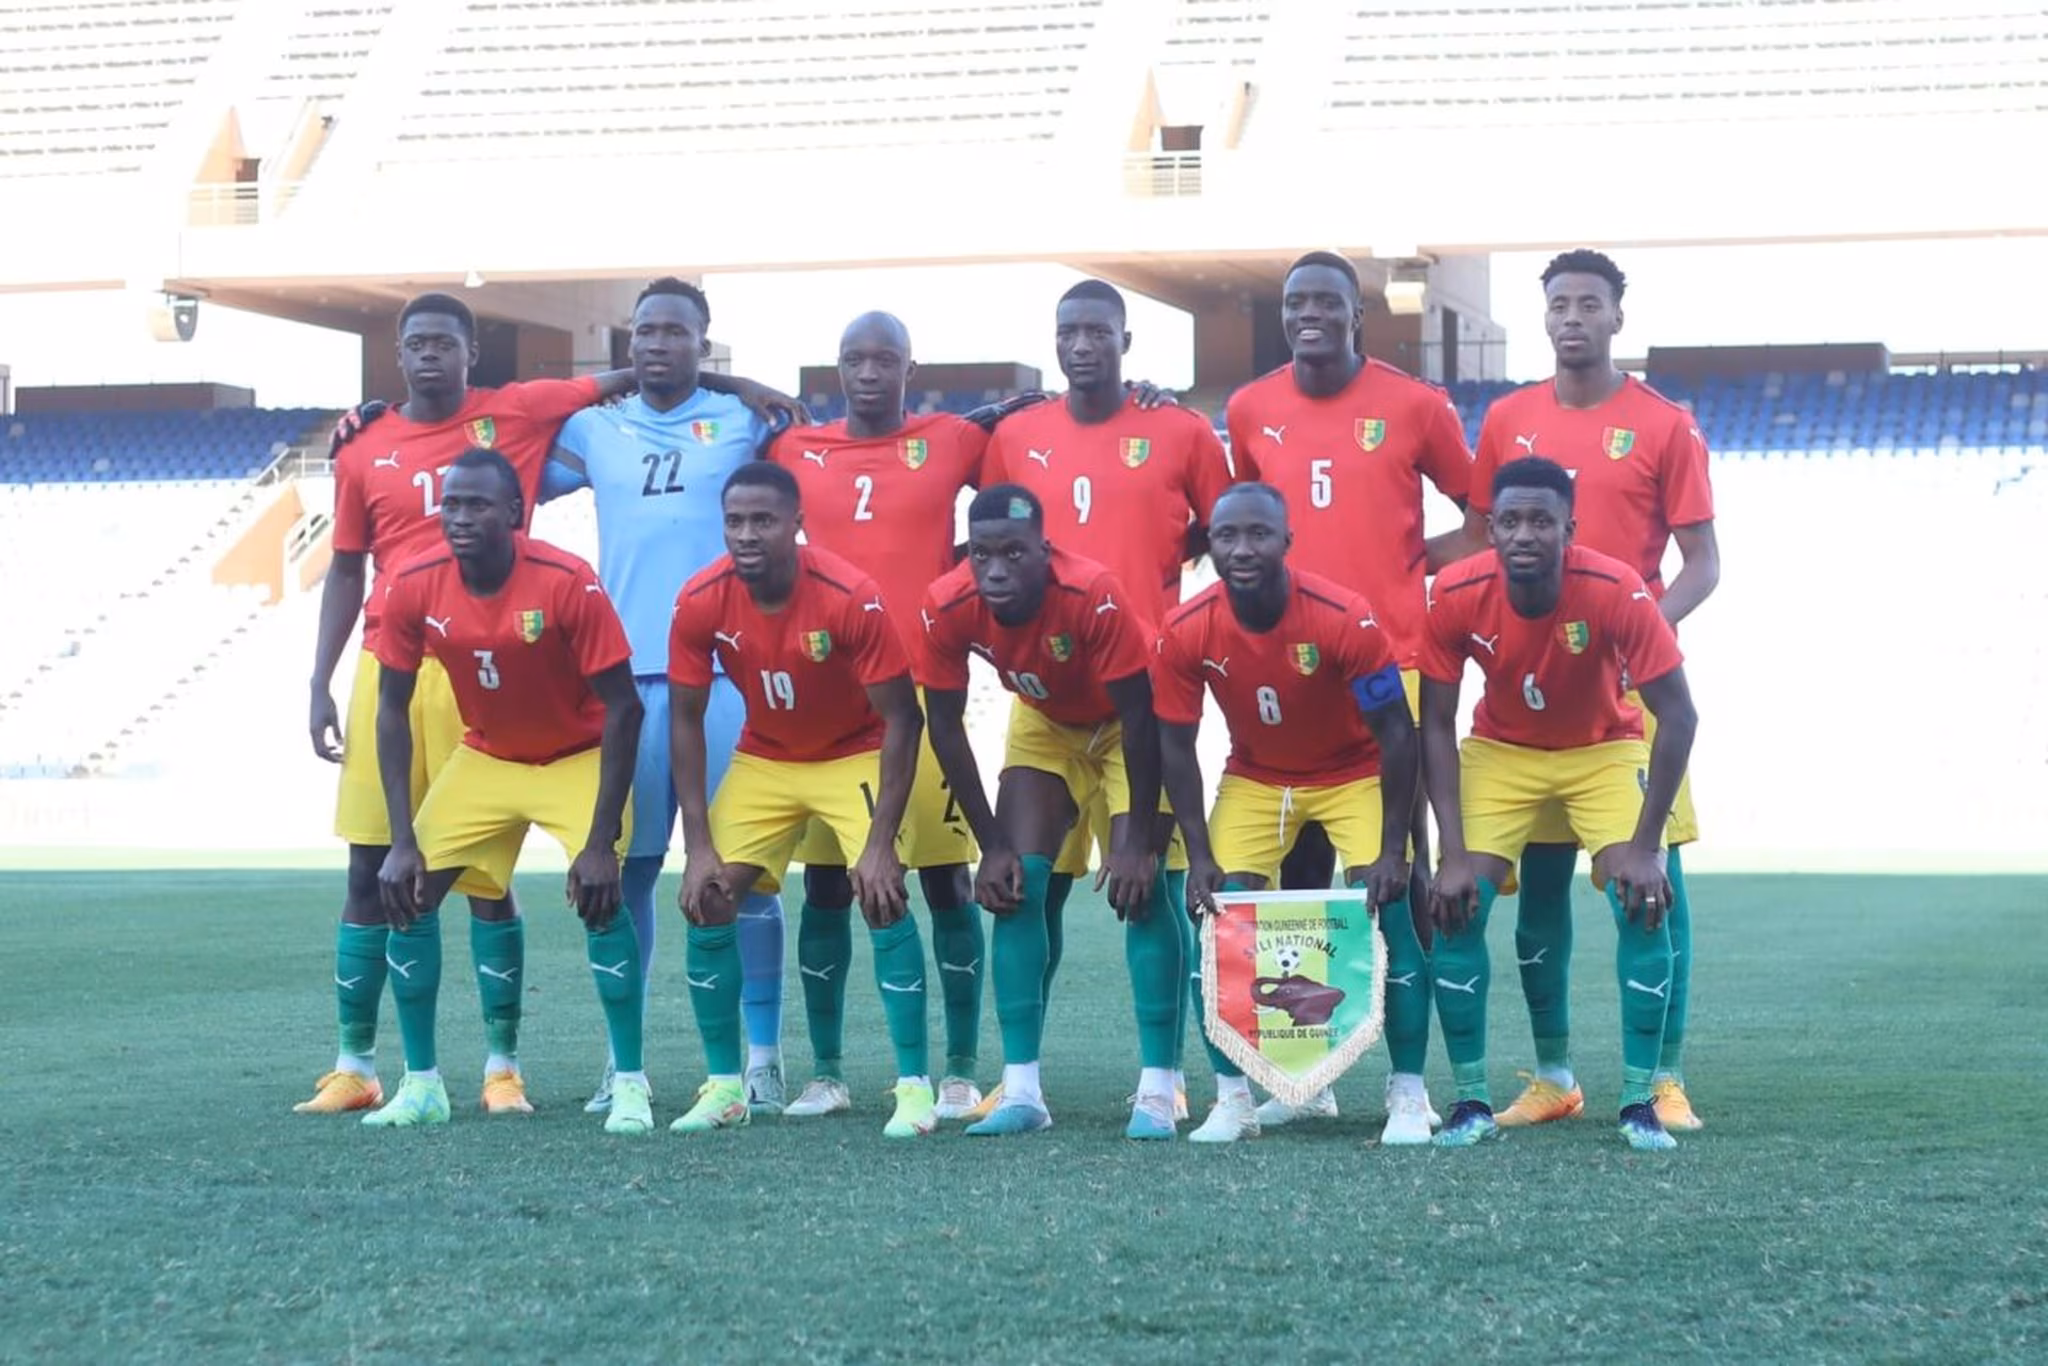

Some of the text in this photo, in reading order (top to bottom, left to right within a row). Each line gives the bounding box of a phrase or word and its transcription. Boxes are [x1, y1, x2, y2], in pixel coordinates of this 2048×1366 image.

[641, 451, 684, 496] 22
[1311, 459, 1333, 508] 5
[854, 475, 873, 521] 2
[1073, 476, 1091, 524] 9
[473, 650, 499, 689] 3
[760, 669, 795, 710] 19
[1007, 670, 1049, 699] 10
[1365, 673, 1393, 702] C
[1256, 685, 1282, 726] 8
[1522, 673, 1545, 711] 6
[1275, 934, 1339, 959] NATIONAL
[1297, 1028, 1307, 1039] DE
